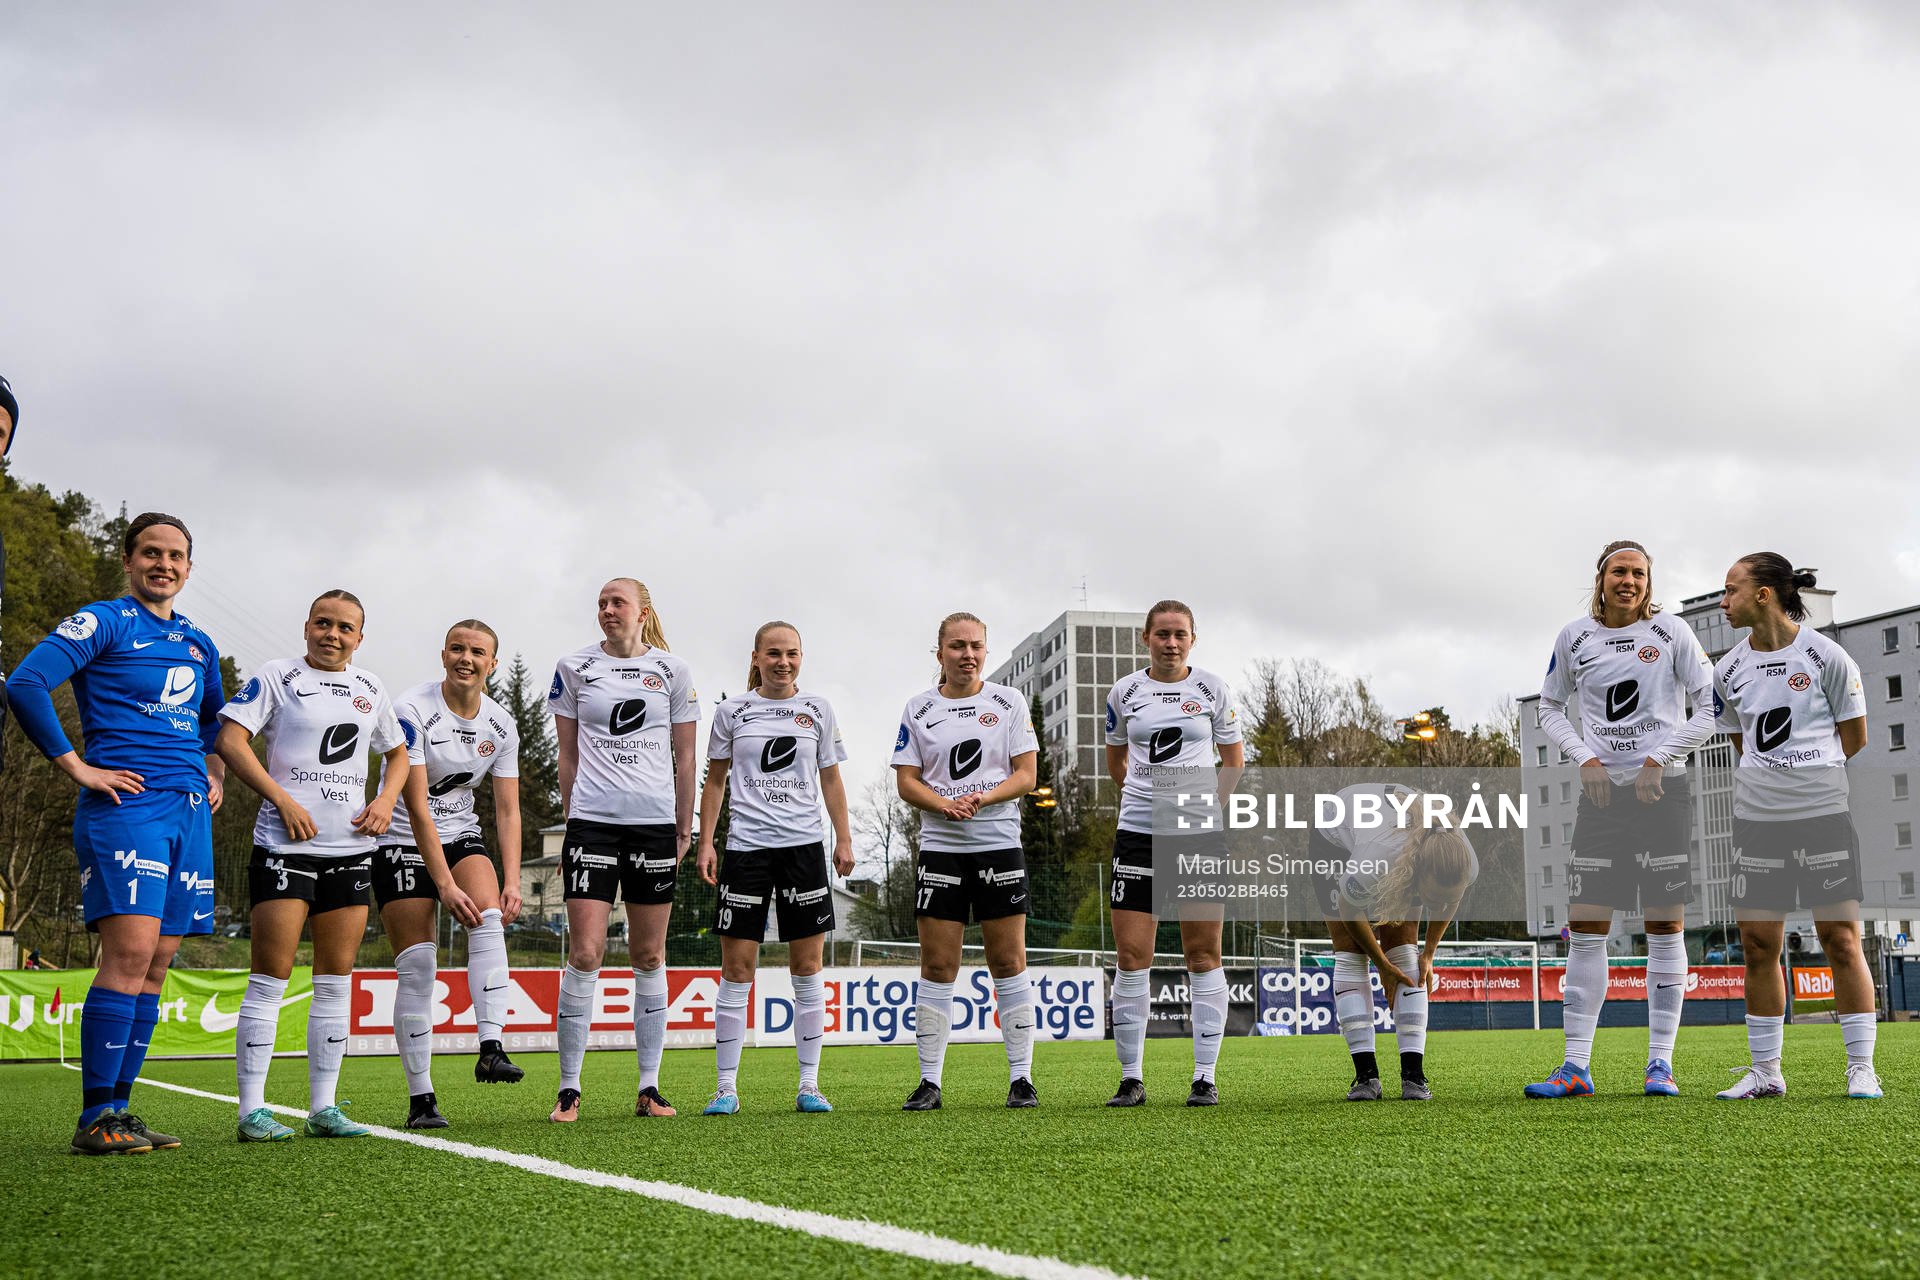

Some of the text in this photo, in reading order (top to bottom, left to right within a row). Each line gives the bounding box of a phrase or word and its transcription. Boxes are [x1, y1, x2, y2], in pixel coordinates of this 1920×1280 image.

[168, 632, 184, 642] RSM
[1616, 645, 1635, 653] RSM
[1766, 668, 1787, 677] RSM
[332, 689, 351, 698] RSM
[775, 709, 794, 717] RSM
[168, 716, 193, 732] Vest
[591, 737, 660, 751] Sparebanken
[1610, 740, 1637, 751] Vest
[612, 753, 639, 765] Vest
[1134, 764, 1200, 777] Sparebanken
[743, 775, 809, 790] Sparebanken
[320, 787, 349, 802] Vest
[764, 792, 789, 803] Vest
[276, 869, 289, 891] 3
[394, 868, 416, 892] 15
[571, 870, 589, 892] 14
[1731, 873, 1747, 898] 10
[128, 878, 138, 905] 1
[917, 887, 934, 910] 17
[718, 907, 733, 930] 19
[1262, 972, 1331, 996] coop
[1797, 971, 1835, 993] Nab
[1262, 1006, 1332, 1031] coop
